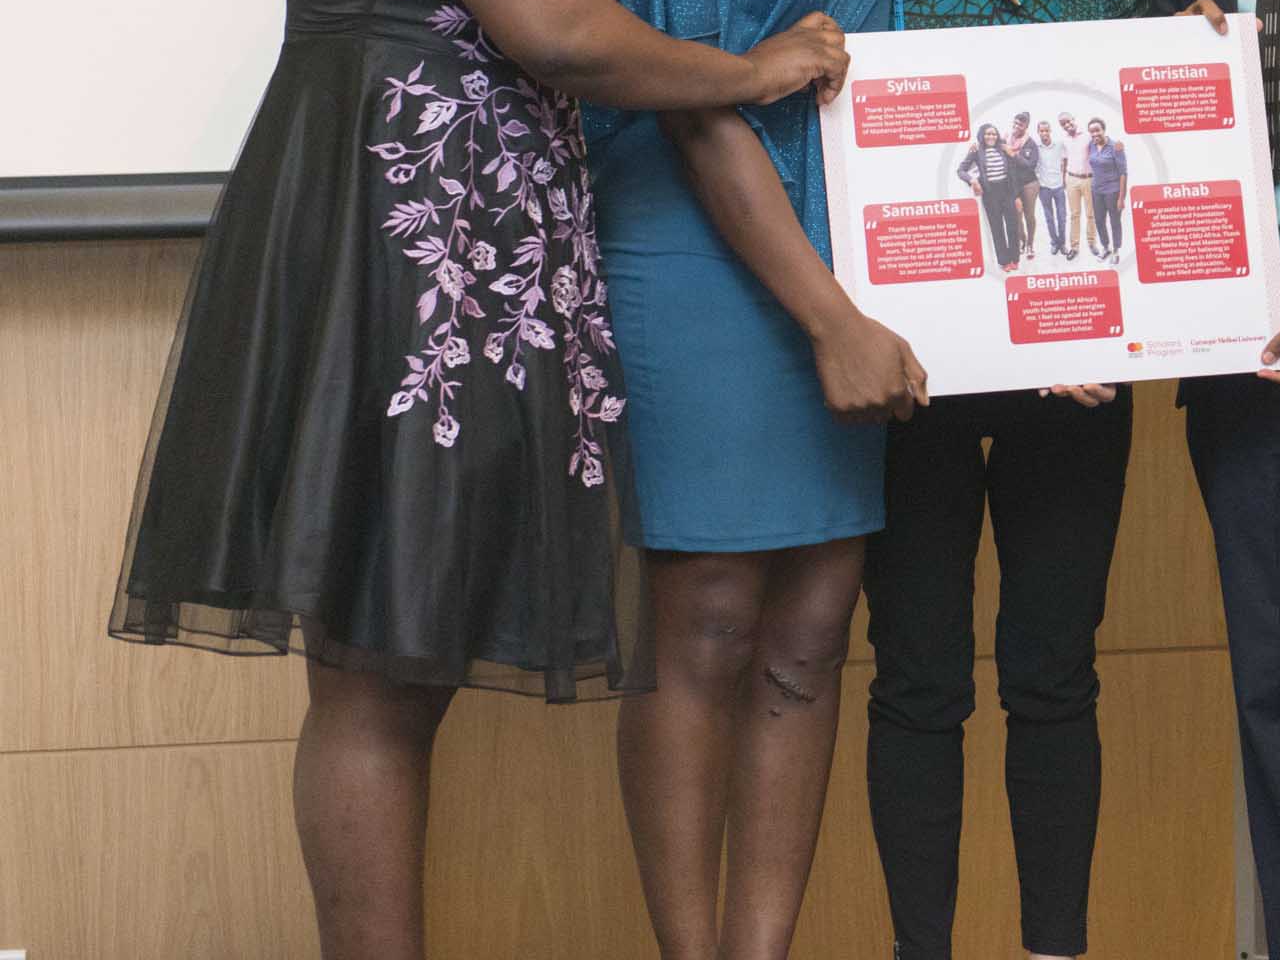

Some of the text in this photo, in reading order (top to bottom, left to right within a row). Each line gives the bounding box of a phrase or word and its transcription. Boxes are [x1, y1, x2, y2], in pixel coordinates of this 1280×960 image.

[1141, 65, 1208, 80] Christian
[887, 78, 931, 95] Sylvia
[1162, 184, 1209, 198] Rahab
[882, 200, 960, 218] Samantha
[1026, 272, 1098, 291] Benjamin
